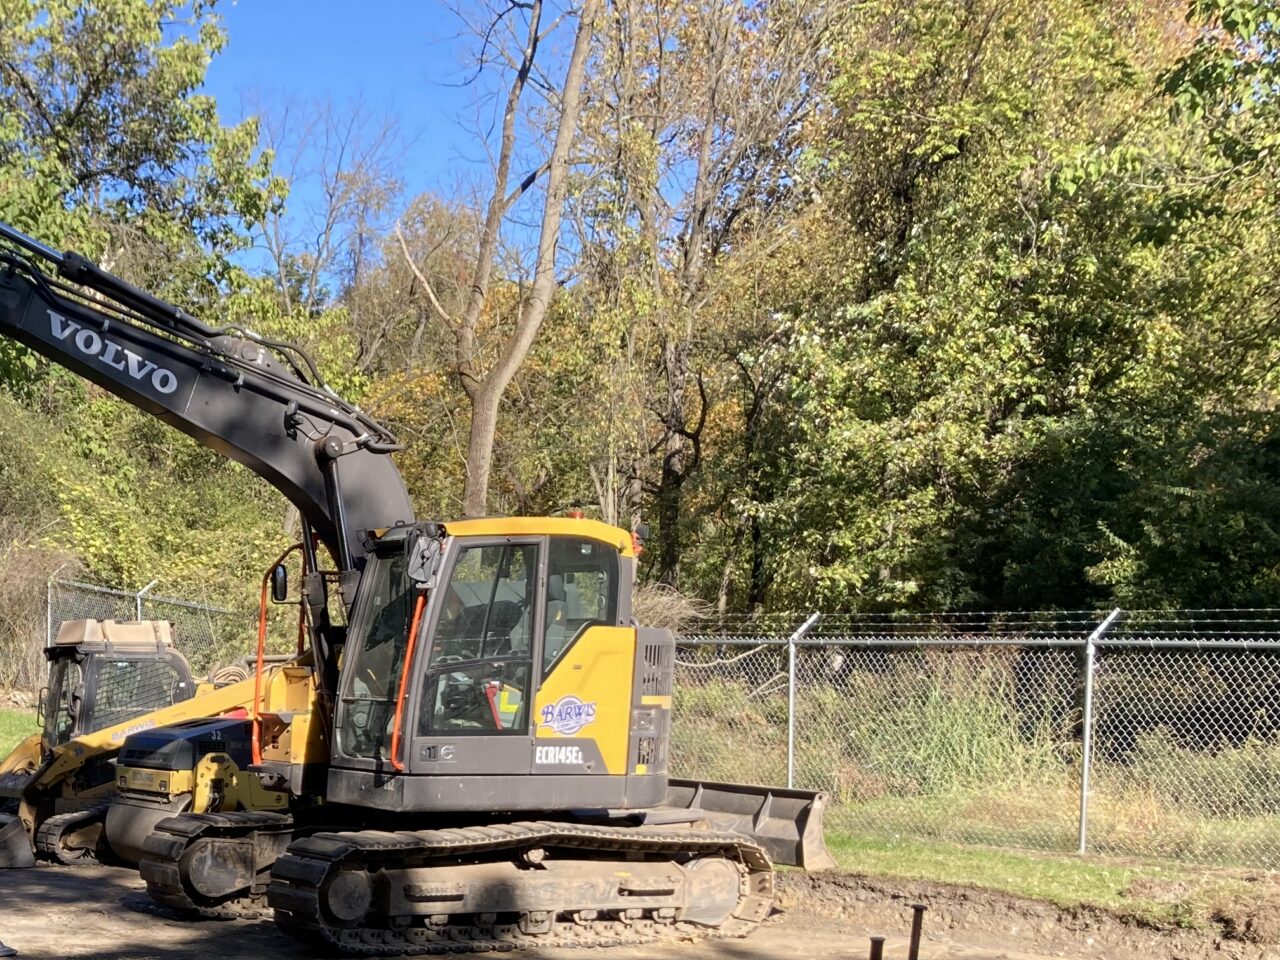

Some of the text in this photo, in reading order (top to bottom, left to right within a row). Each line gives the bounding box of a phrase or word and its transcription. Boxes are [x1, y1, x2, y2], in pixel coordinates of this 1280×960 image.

[46, 309, 178, 394] VOLVO
[541, 703, 597, 724] BARWIS
[111, 719, 155, 741] BARWIS
[211, 730, 223, 740] 32
